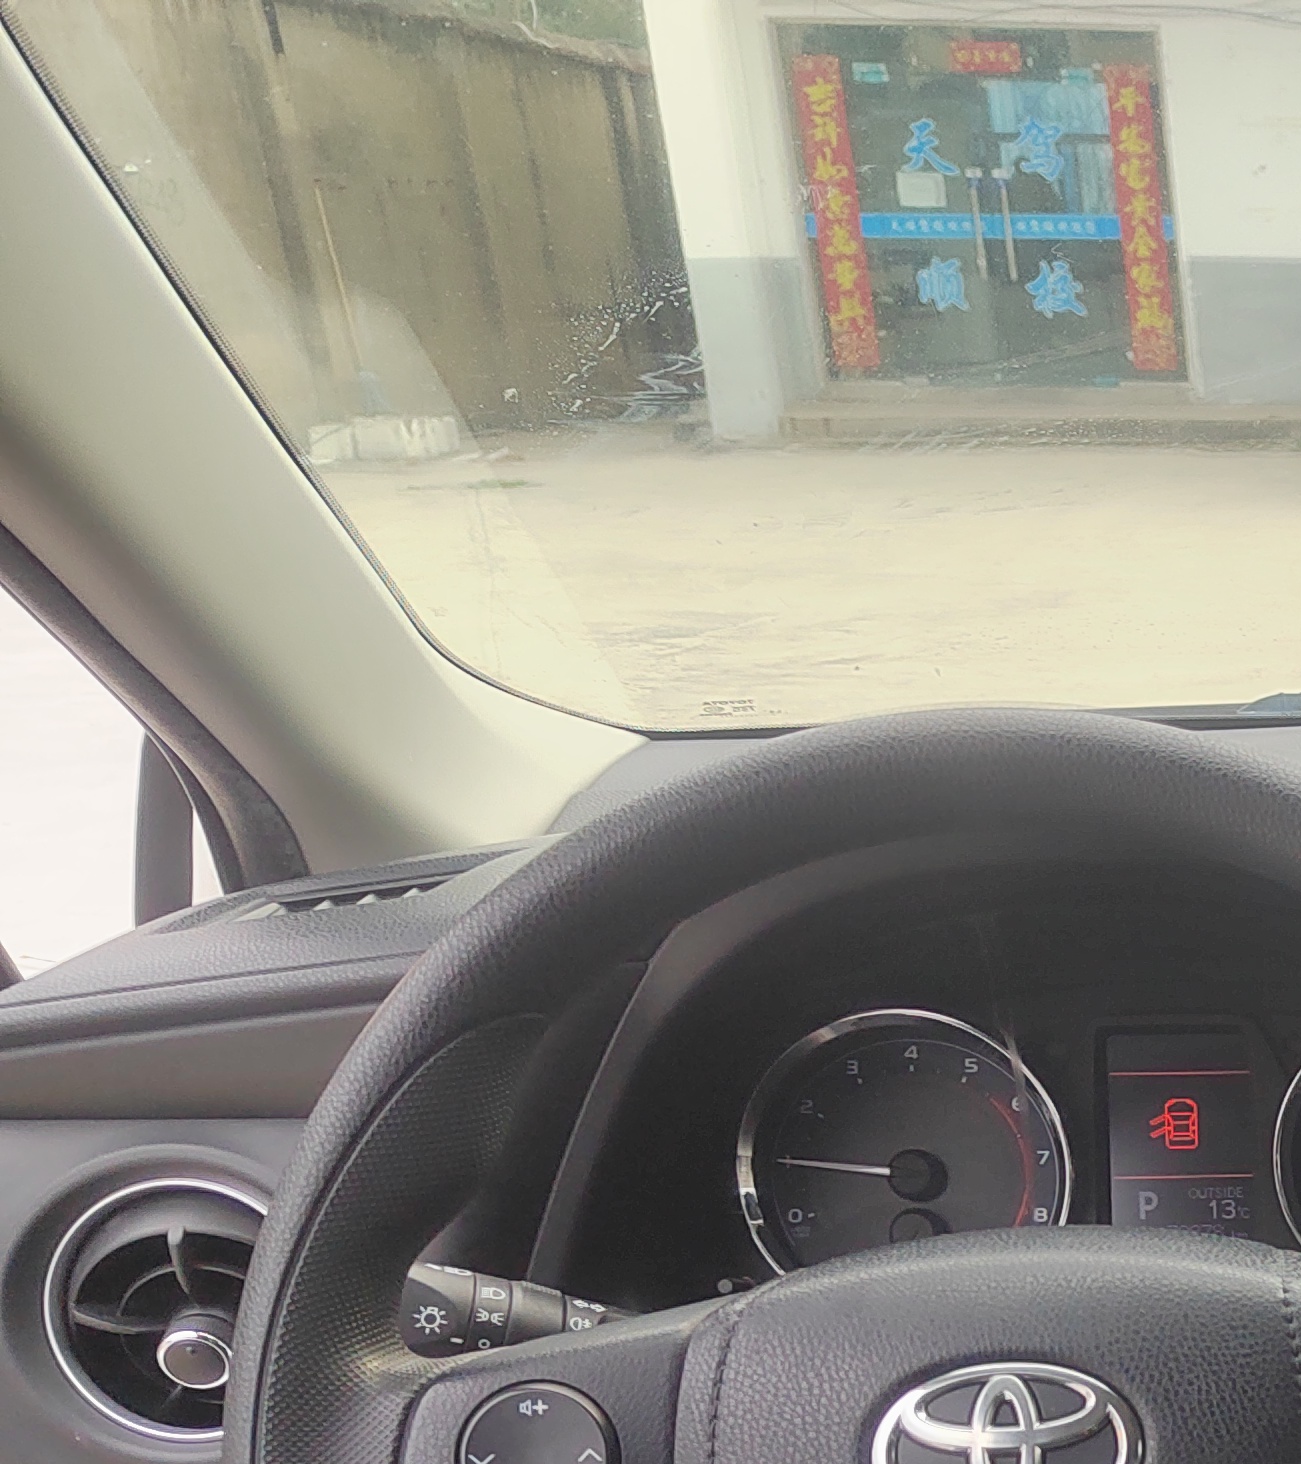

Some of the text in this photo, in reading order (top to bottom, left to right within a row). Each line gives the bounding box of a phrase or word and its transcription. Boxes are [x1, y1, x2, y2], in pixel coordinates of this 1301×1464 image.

[904, 1045, 918, 1060] 4
[846, 1060, 859, 1075] 3
[964, 1058, 979, 1073] 5
[800, 1100, 814, 1114] 2
[1037, 1150, 1051, 1165] 7
[1187, 1186, 1244, 1200] OUTSIDE
[1138, 1191, 1159, 1220] P
[788, 1208, 803, 1223] 0
[1033, 1208, 1048, 1223] 8
